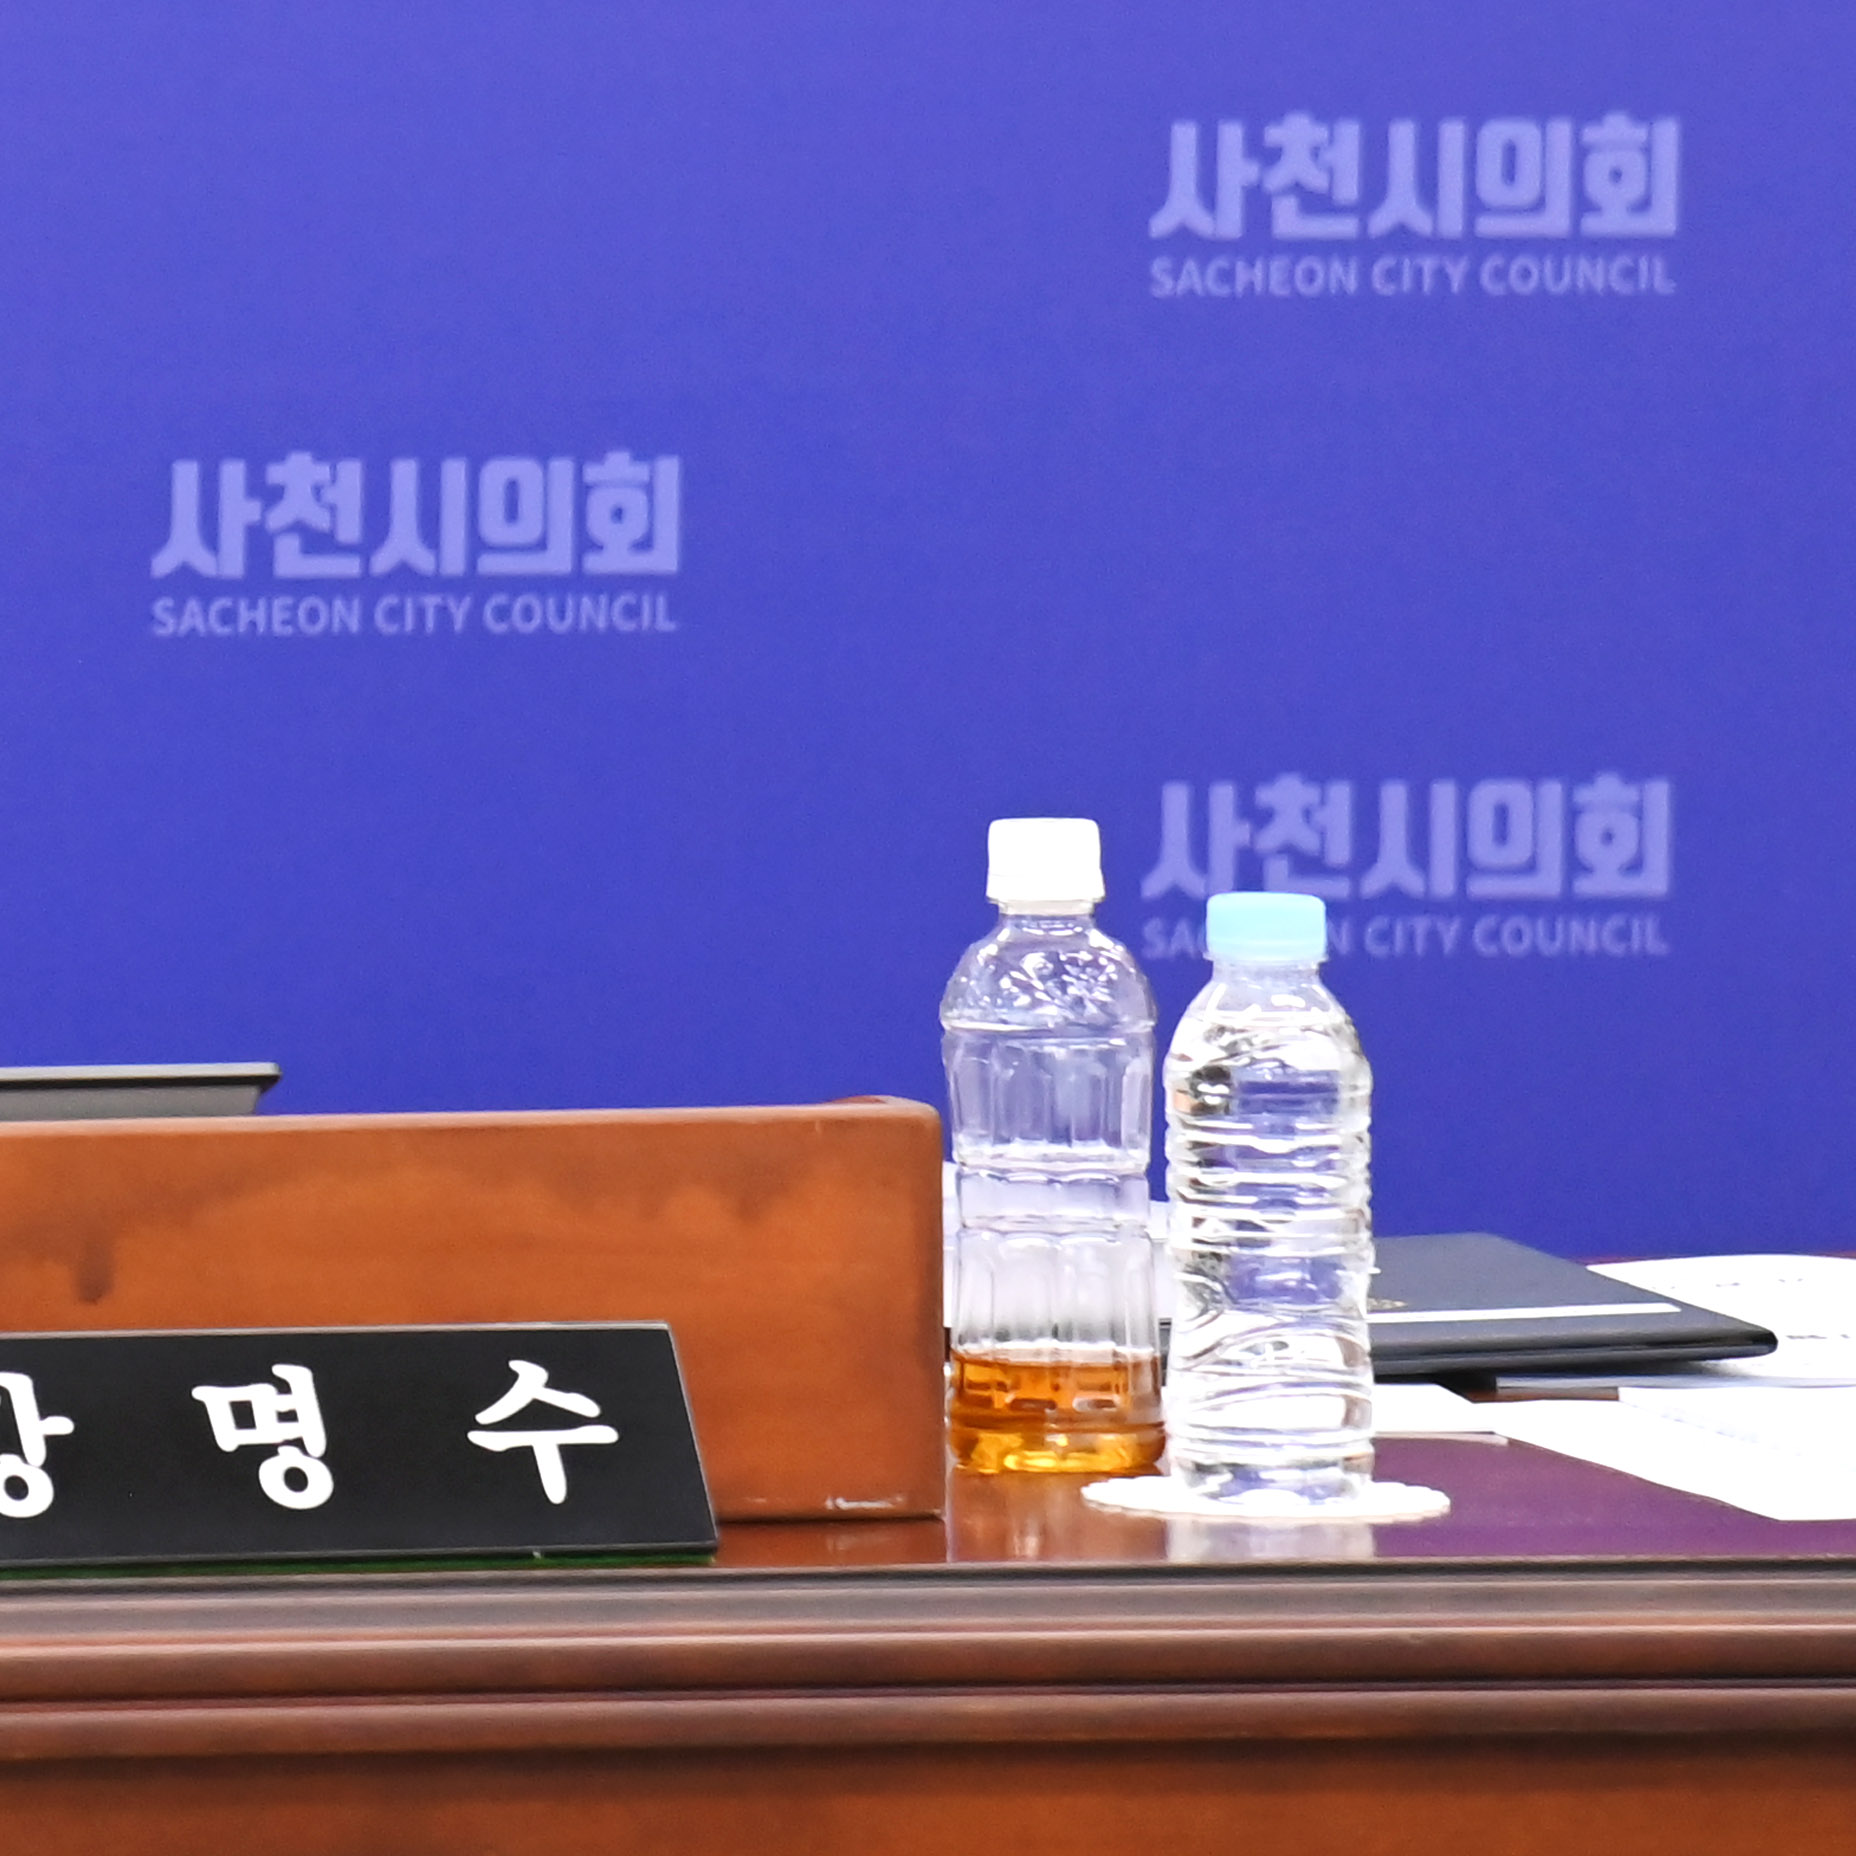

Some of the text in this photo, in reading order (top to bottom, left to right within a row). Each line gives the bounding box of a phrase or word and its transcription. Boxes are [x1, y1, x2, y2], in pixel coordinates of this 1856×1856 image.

[1149, 110, 1681, 240] 사천시의회
[1150, 254, 1675, 297] SACHEON CITY COUNCIL
[151, 449, 682, 579] 사천시의회
[152, 592, 677, 637] SACHEON CITY COUNCIL
[1141, 773, 1672, 900] 사천시의회
[1364, 914, 1460, 956] CITY
[1472, 911, 1668, 956] COUNCIL
